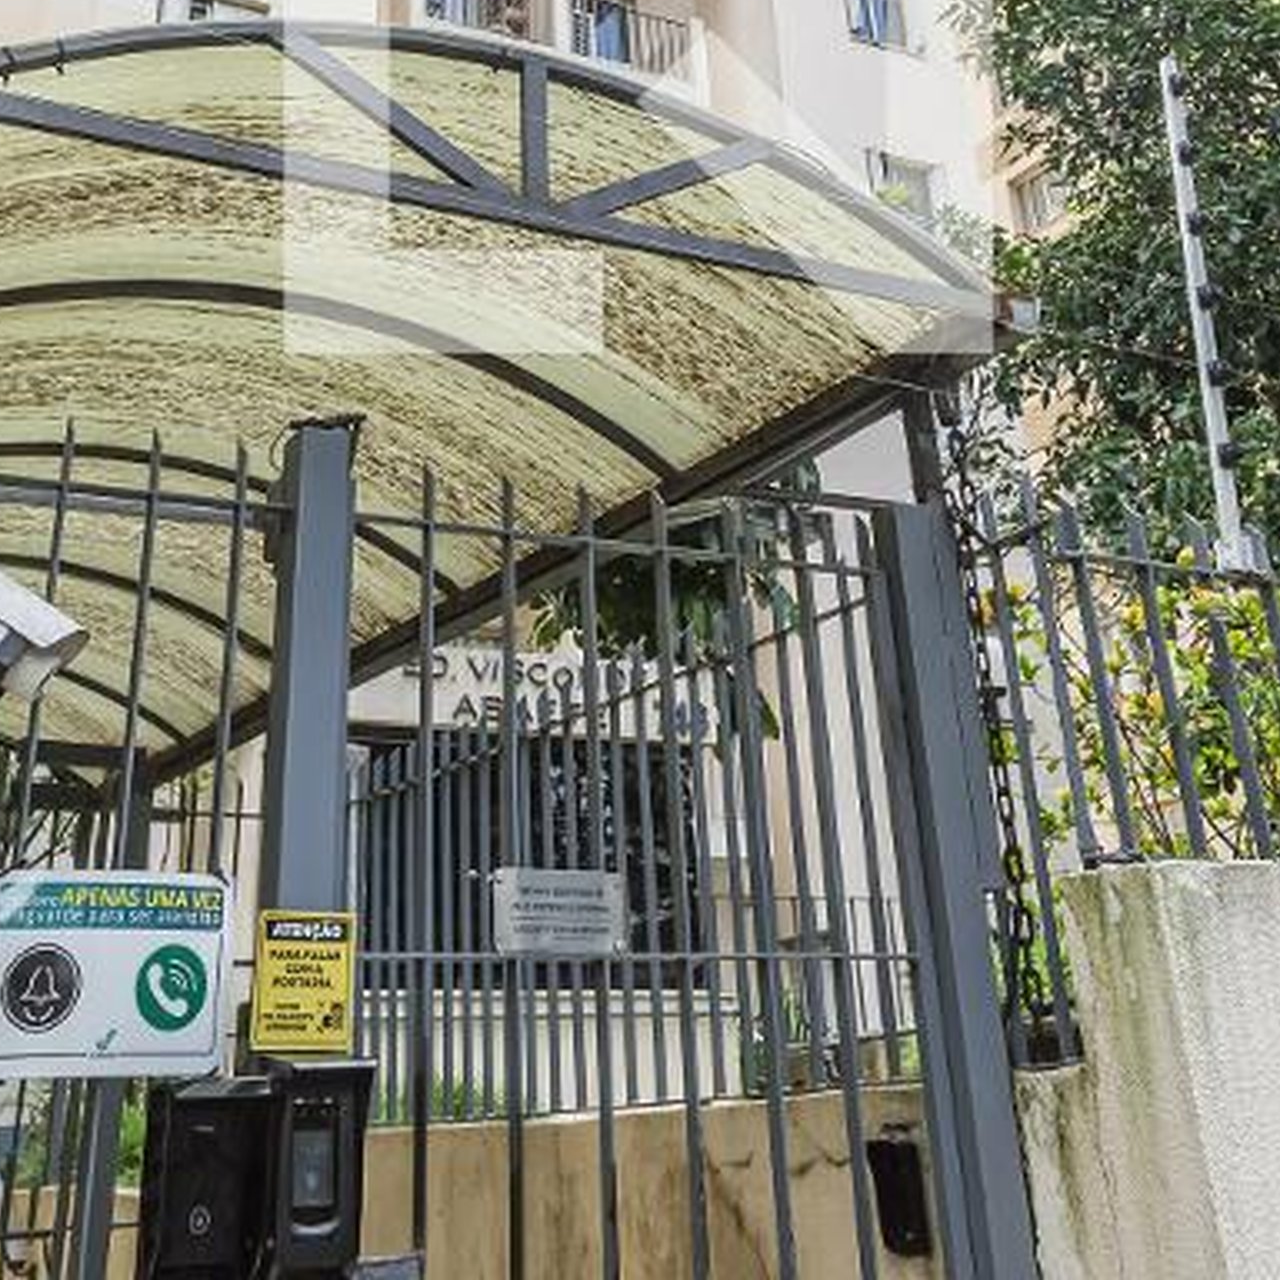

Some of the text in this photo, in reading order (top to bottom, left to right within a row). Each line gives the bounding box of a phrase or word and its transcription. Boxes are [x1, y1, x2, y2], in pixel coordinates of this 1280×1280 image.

[61, 885, 140, 908] APENAS
[144, 888, 188, 908] UMA
[192, 890, 222, 912] VEZ
